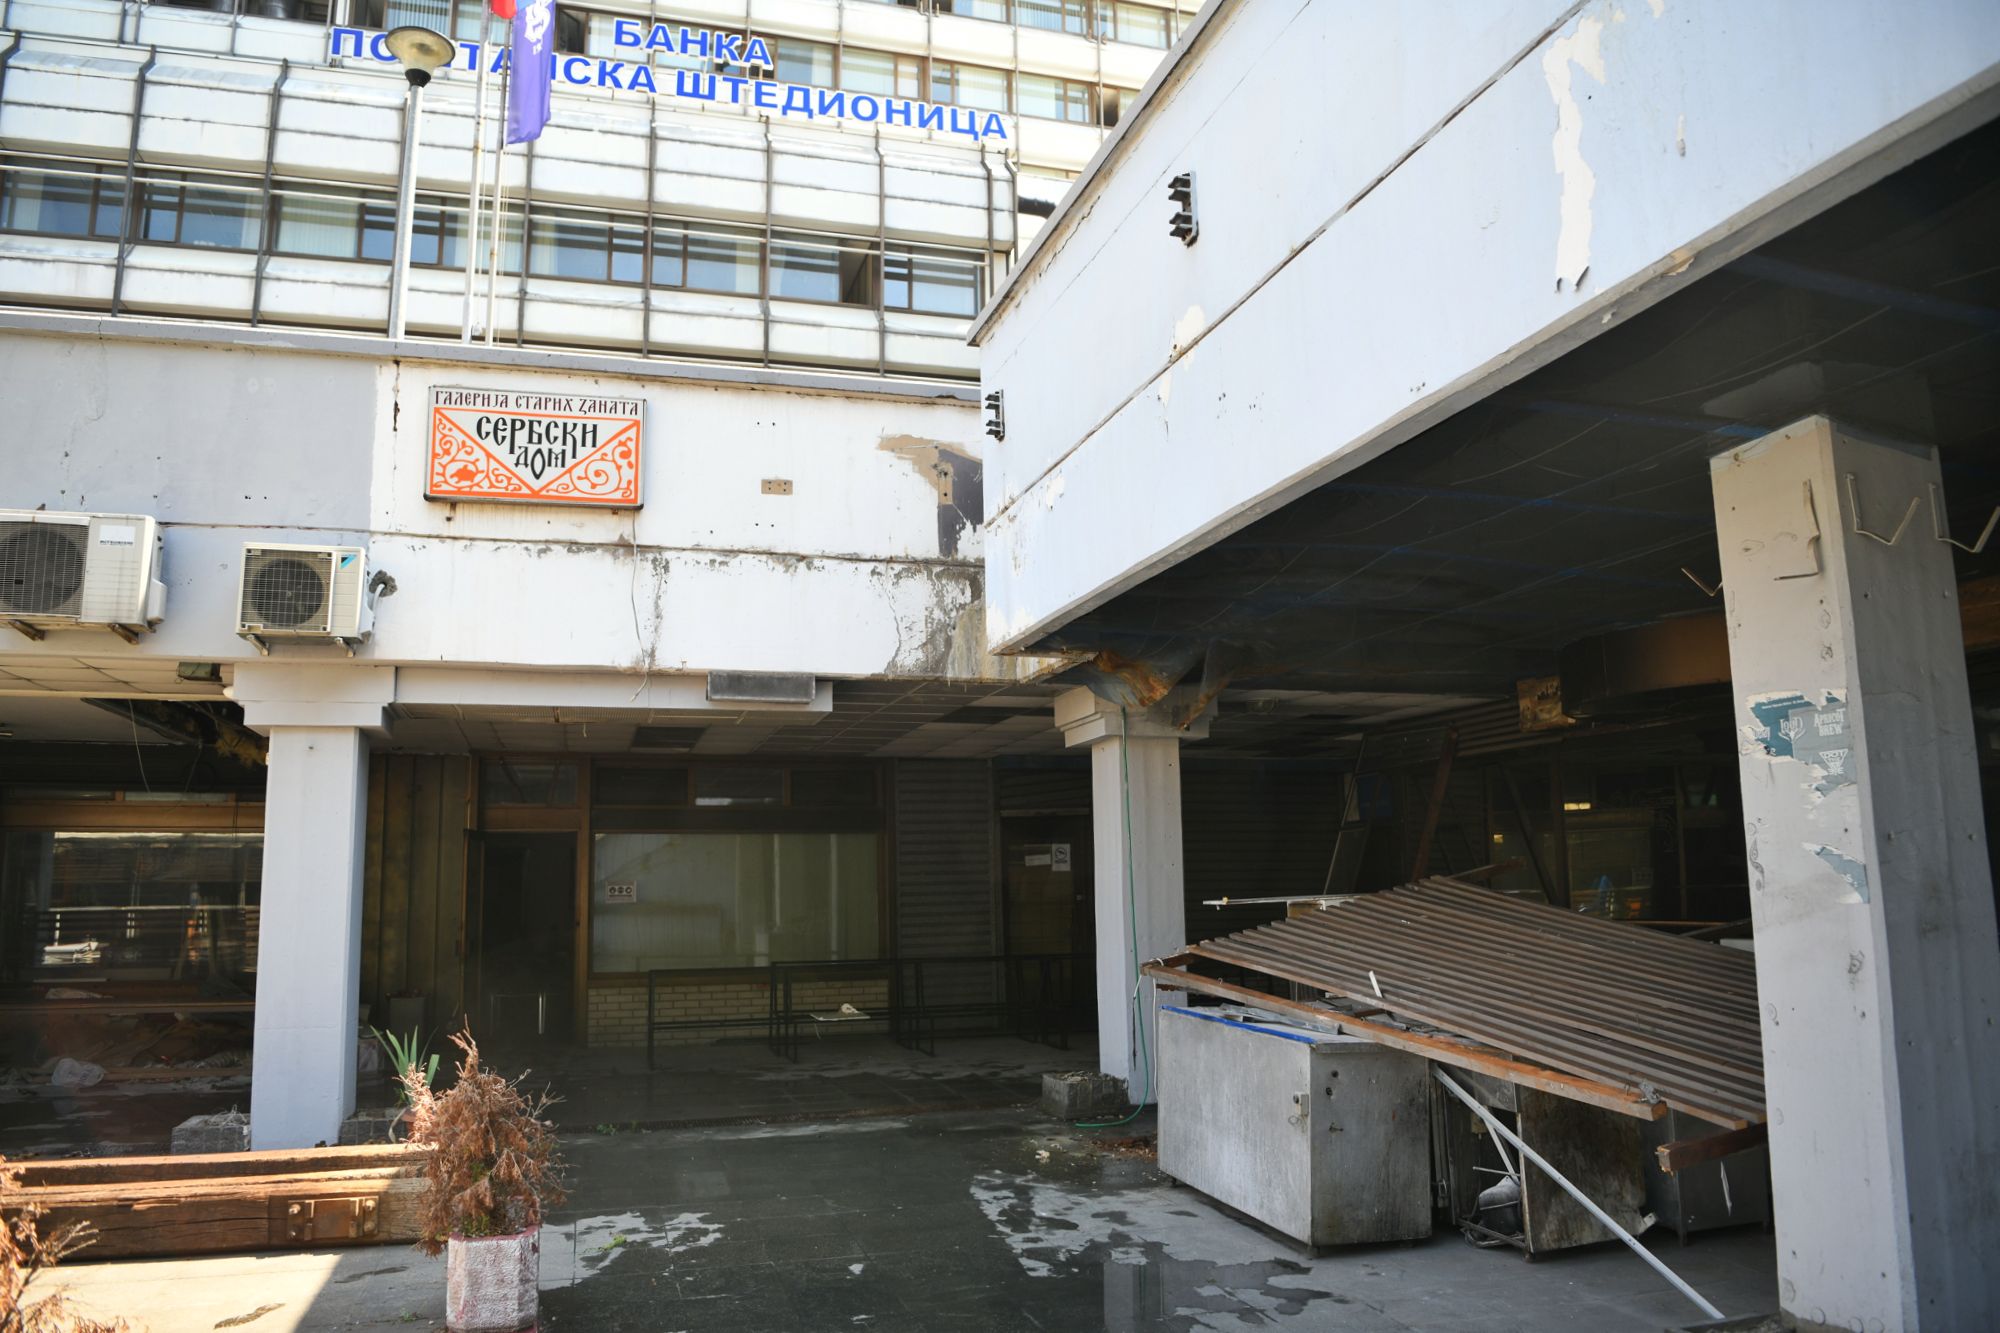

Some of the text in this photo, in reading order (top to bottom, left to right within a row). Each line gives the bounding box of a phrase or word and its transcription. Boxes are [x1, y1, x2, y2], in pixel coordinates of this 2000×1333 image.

[613, 18, 774, 66] БАНКА
[331, 27, 1008, 141] ПОТАСКА ШТЕДИОНИЦА
[435, 390, 509, 409] ГАЛЕРИЈА
[515, 395, 574, 412] СТАРИХ
[514, 445, 567, 480] ДОМ
